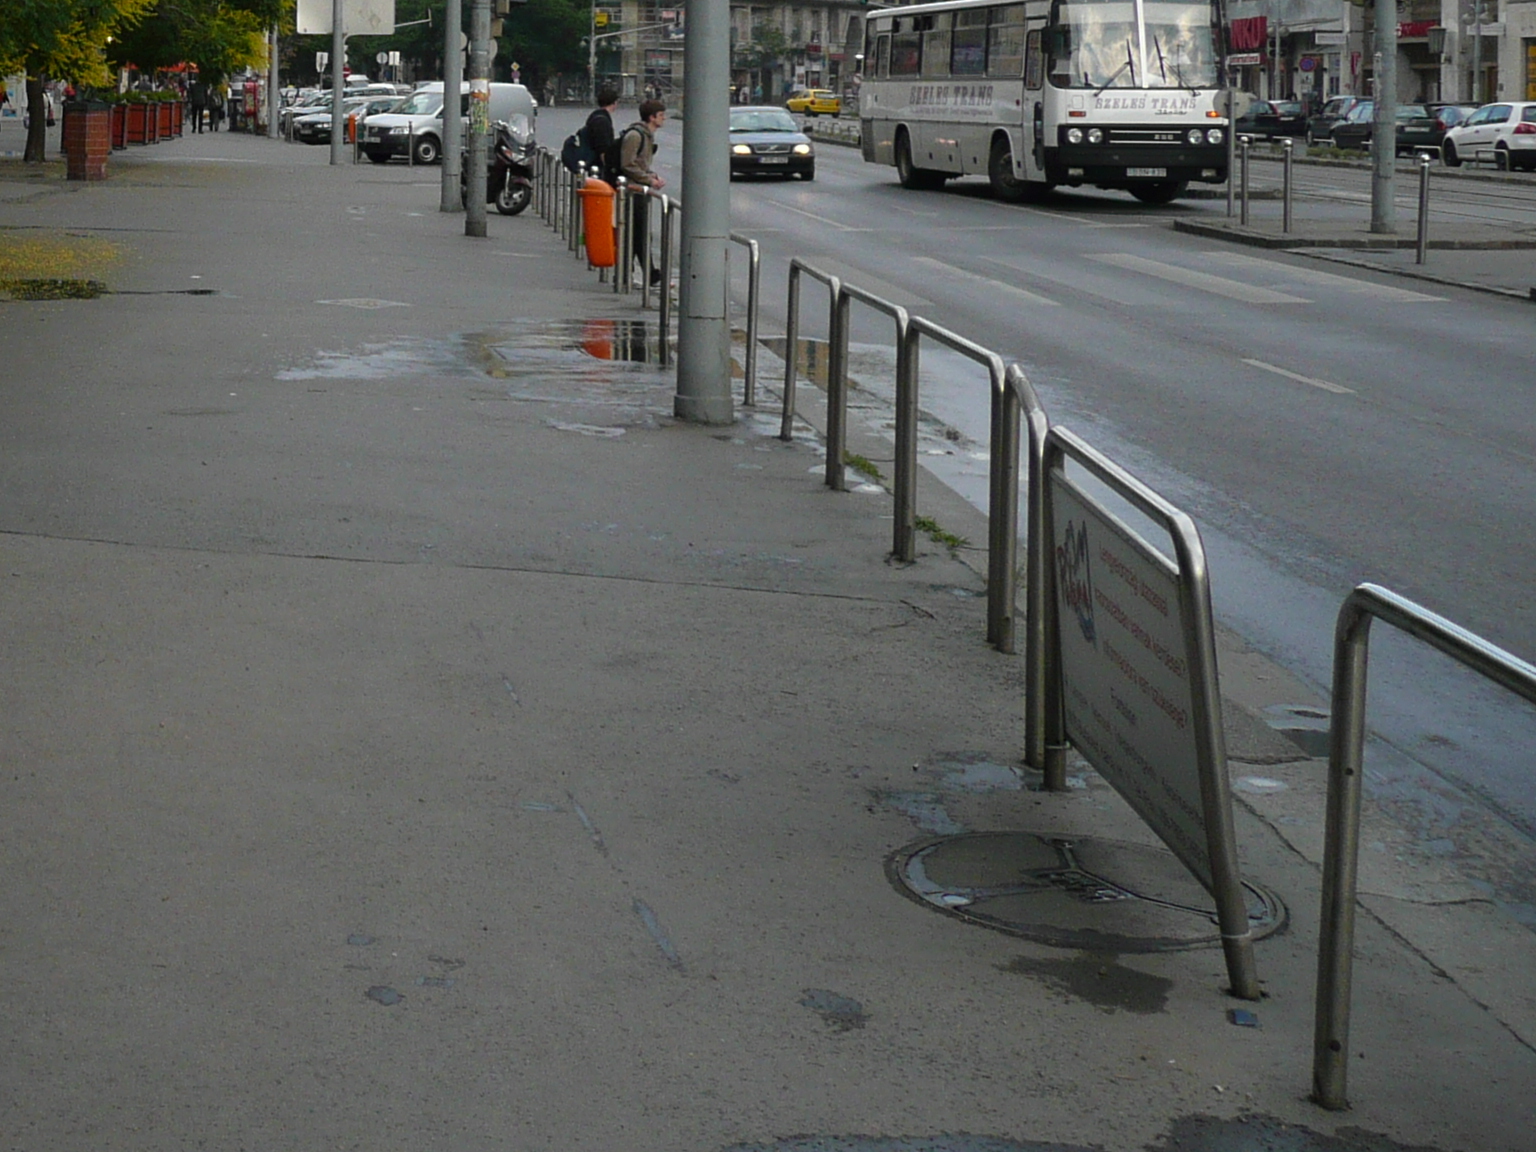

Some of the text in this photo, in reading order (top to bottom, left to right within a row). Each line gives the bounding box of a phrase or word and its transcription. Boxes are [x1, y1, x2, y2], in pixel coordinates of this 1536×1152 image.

[953, 85, 994, 106] TRANS
[1094, 97, 1197, 110] SZELES TRANS
